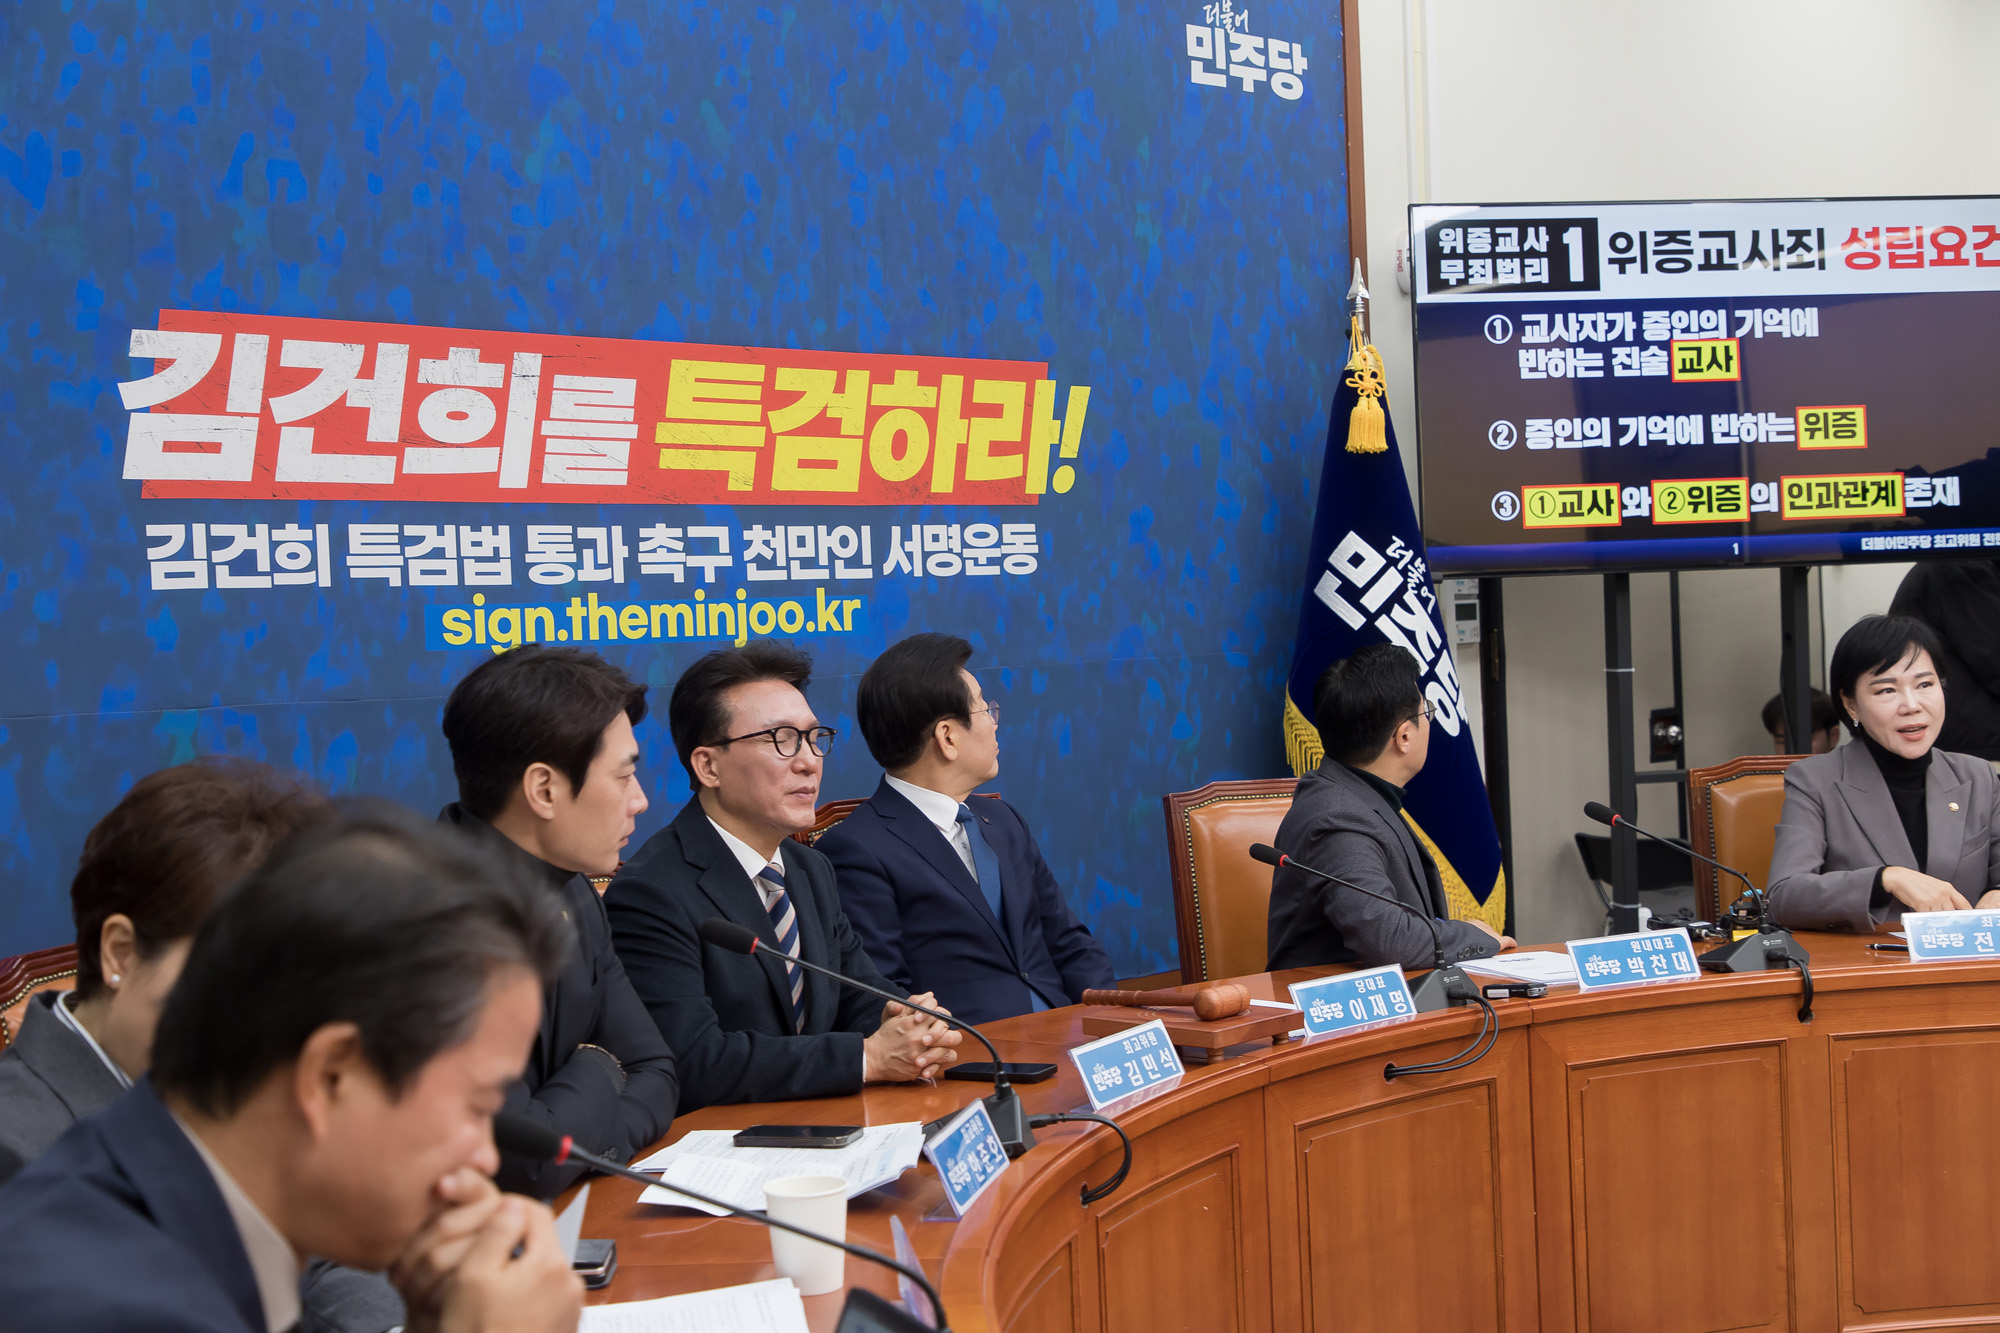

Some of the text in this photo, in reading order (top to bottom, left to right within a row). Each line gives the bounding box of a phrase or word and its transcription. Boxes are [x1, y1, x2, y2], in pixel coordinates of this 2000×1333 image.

[1203, 0, 1249, 33] 더불어
[1186, 24, 1308, 100] 민주당
[1438, 226, 1549, 254] 위증교사
[1562, 226, 1584, 282] 1
[1607, 227, 1826, 275] 위증교사죄
[1440, 257, 1549, 285] 무죄법리
[1521, 311, 1636, 344] 교사자가
[1642, 309, 1728, 341] 증인의
[1735, 307, 1819, 338] 기억에
[1518, 345, 1734, 379] 반하는 진술 교사
[117, 329, 1091, 495] 김건희를 특검하라!
[1525, 417, 1611, 450] 증인의
[1618, 414, 1703, 447] 기억에
[1711, 412, 1795, 445] 반하는
[1803, 411, 1857, 441] 위증
[1787, 479, 1896, 511] 인과관계
[1904, 476, 1960, 508] 존재
[146, 523, 1038, 591] 김건희 특검법 통과 촉구 천만인 서명운동
[1861, 535, 1932, 550] 더불어민주당
[442, 587, 861, 655] sign.theminjoo.kr
[1314, 530, 1469, 737] 민주당
[1630, 936, 1675, 954] 원내대표
[1921, 931, 1995, 952] 민주당 전
[1585, 951, 1692, 978] 민주당 박찬대
[1354, 976, 1386, 994] 당대표
[1309, 990, 1408, 1023] 민주당 이재명
[1122, 1031, 1158, 1055] 최고위원
[1091, 1047, 1177, 1092] 민주당 김민석
